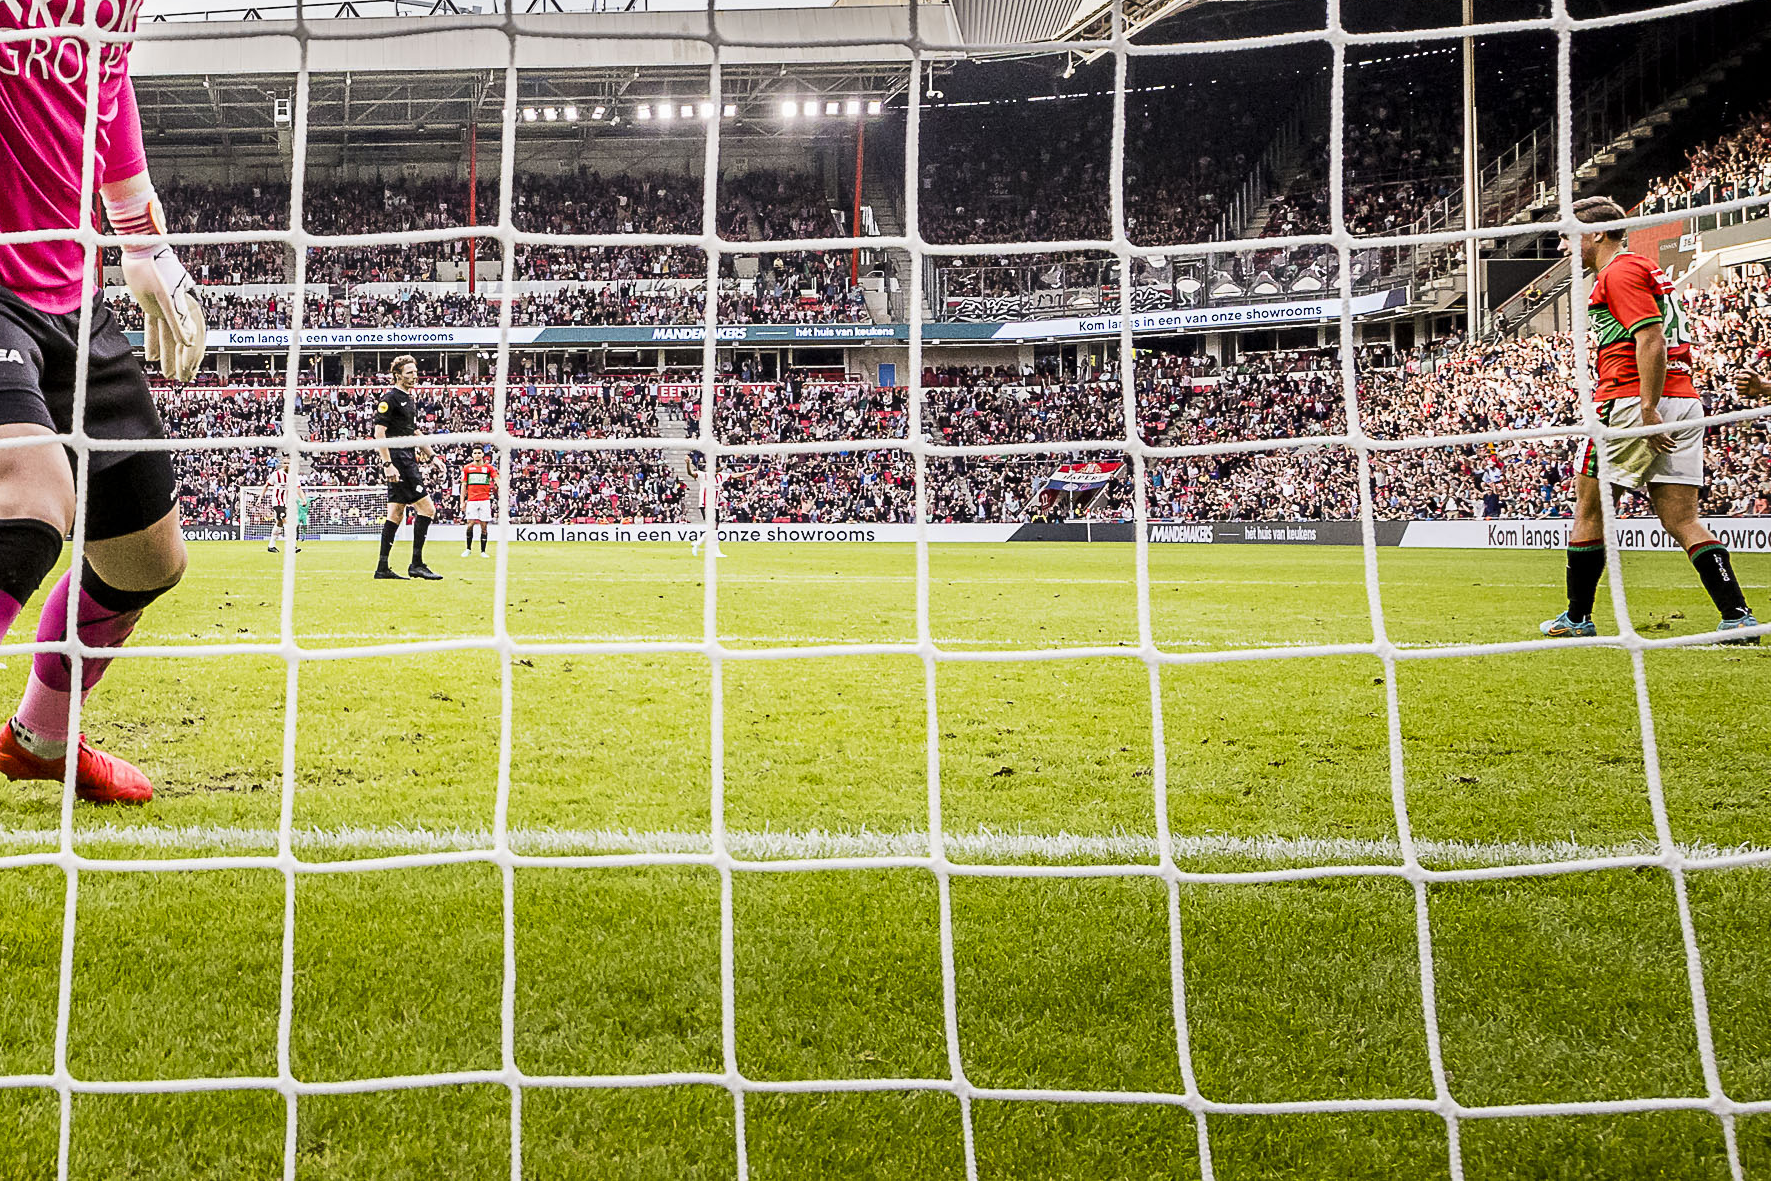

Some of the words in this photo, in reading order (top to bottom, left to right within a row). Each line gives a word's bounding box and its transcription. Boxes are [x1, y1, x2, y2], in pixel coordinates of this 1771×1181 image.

[1079, 320, 1105, 332] Kom
[1143, 316, 1155, 327] in
[1158, 315, 1181, 326] een
[1185, 313, 1207, 324] van
[1211, 310, 1242, 322] onze
[1246, 305, 1322, 319] showrooms
[229, 333, 255, 344] Kom
[258, 332, 289, 346] langs
[306, 334, 328, 343] een
[331, 334, 352, 343] van
[355, 334, 383, 343] onze
[387, 332, 454, 343] showrooms
[652, 327, 748, 340] MANDEMKERS
[795, 326, 812, 337] hét
[814, 326, 834, 337] huis
[836, 328, 853, 337] van
[854, 327, 895, 337] keukens
[516, 527, 555, 542] Kom
[561, 527, 609, 542] langs
[615, 528, 629, 542] in
[637, 530, 672, 542] een
[717, 530, 761, 542] onze
[767, 527, 876, 542] showrooms
[1149, 525, 1213, 543] MANDEMAKERS
[1244, 526, 1257, 540] hét
[1257, 526, 1272, 540] huis
[1273, 528, 1286, 540] van
[1287, 526, 1316, 541] keukens
[1488, 524, 1519, 547] Kom
[1522, 524, 1559, 549] langs
[1616, 529, 1646, 548] van
